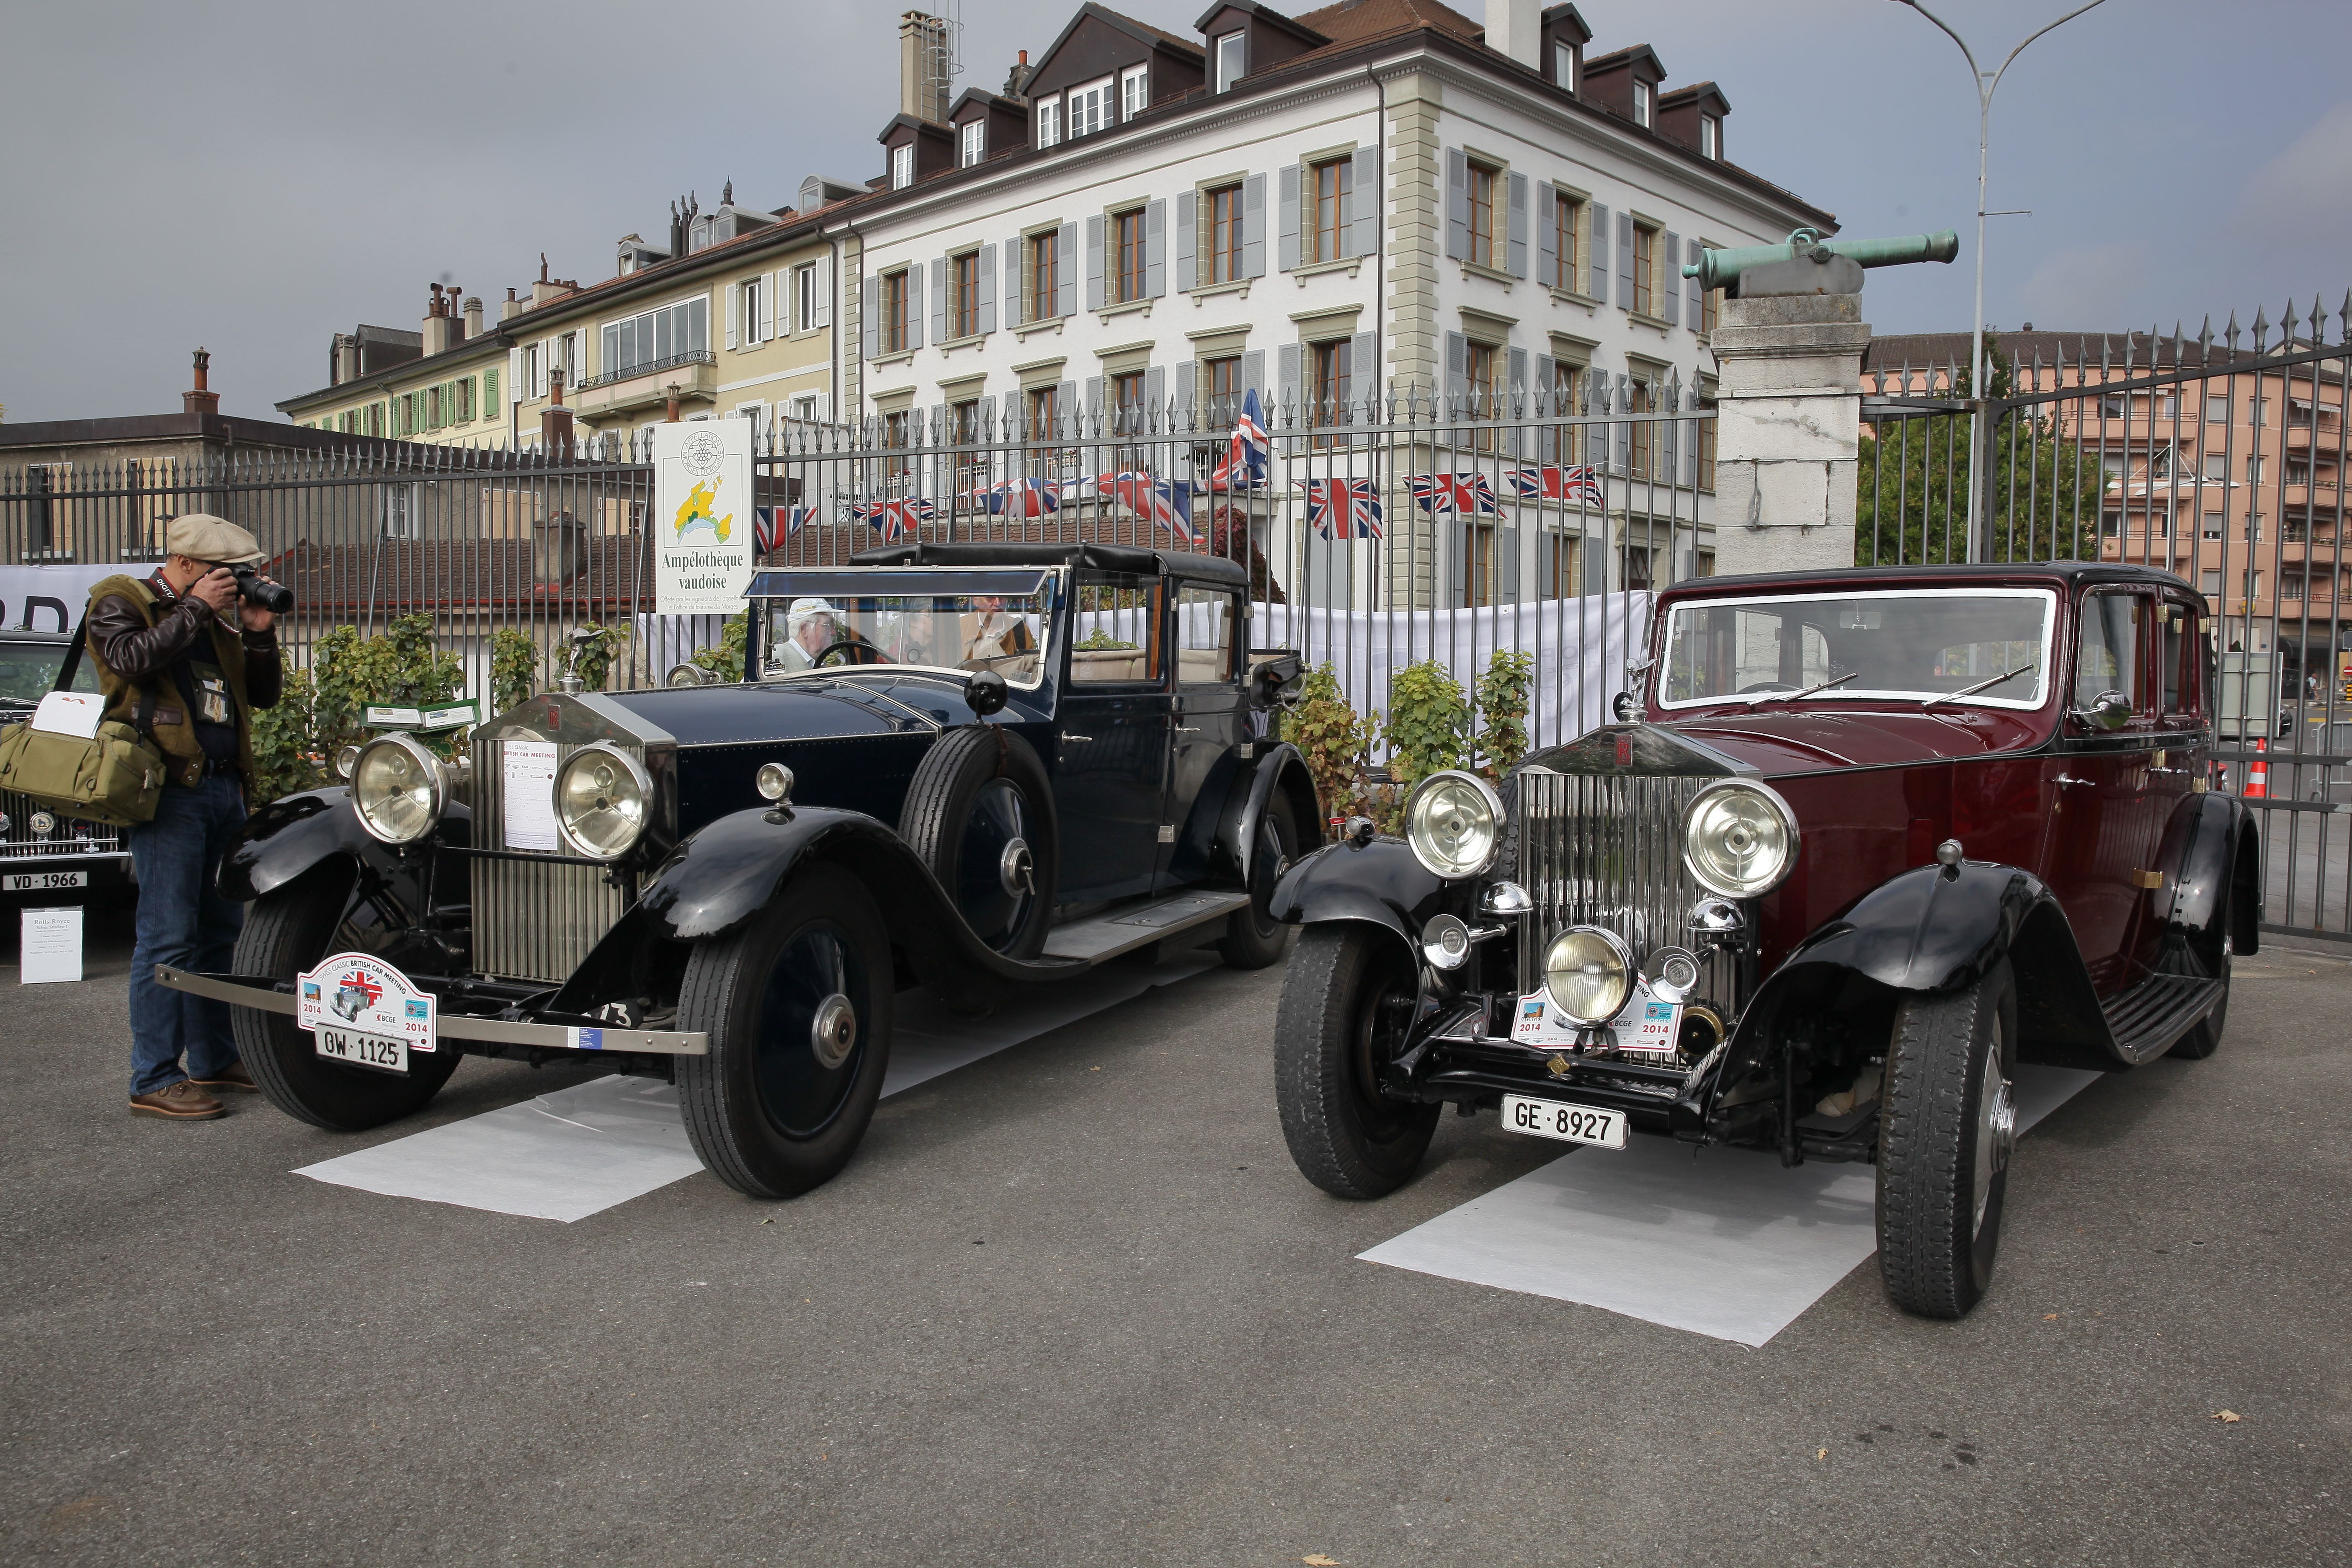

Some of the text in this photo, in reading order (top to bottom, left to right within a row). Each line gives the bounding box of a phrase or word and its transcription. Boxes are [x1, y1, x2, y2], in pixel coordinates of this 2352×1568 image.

[685, 432, 721, 449] APPELLATION
[682, 451, 699, 475] MORGES
[661, 550, 743, 572] Ampélothèque
[678, 573, 727, 590] vaudoise
[319, 967, 332, 981] SWISS
[331, 960, 350, 972] CLASSIC
[350, 960, 371, 970] BRITISH
[371, 965, 383, 975] CAR
[383, 972, 407, 995] MEETING
[304, 1003, 322, 1015] 2014
[382, 1015, 396, 1024] BCGE
[405, 1022, 428, 1033] 2014
[1519, 1023, 1541, 1032] 2014
[1642, 1024, 1669, 1034] 2014
